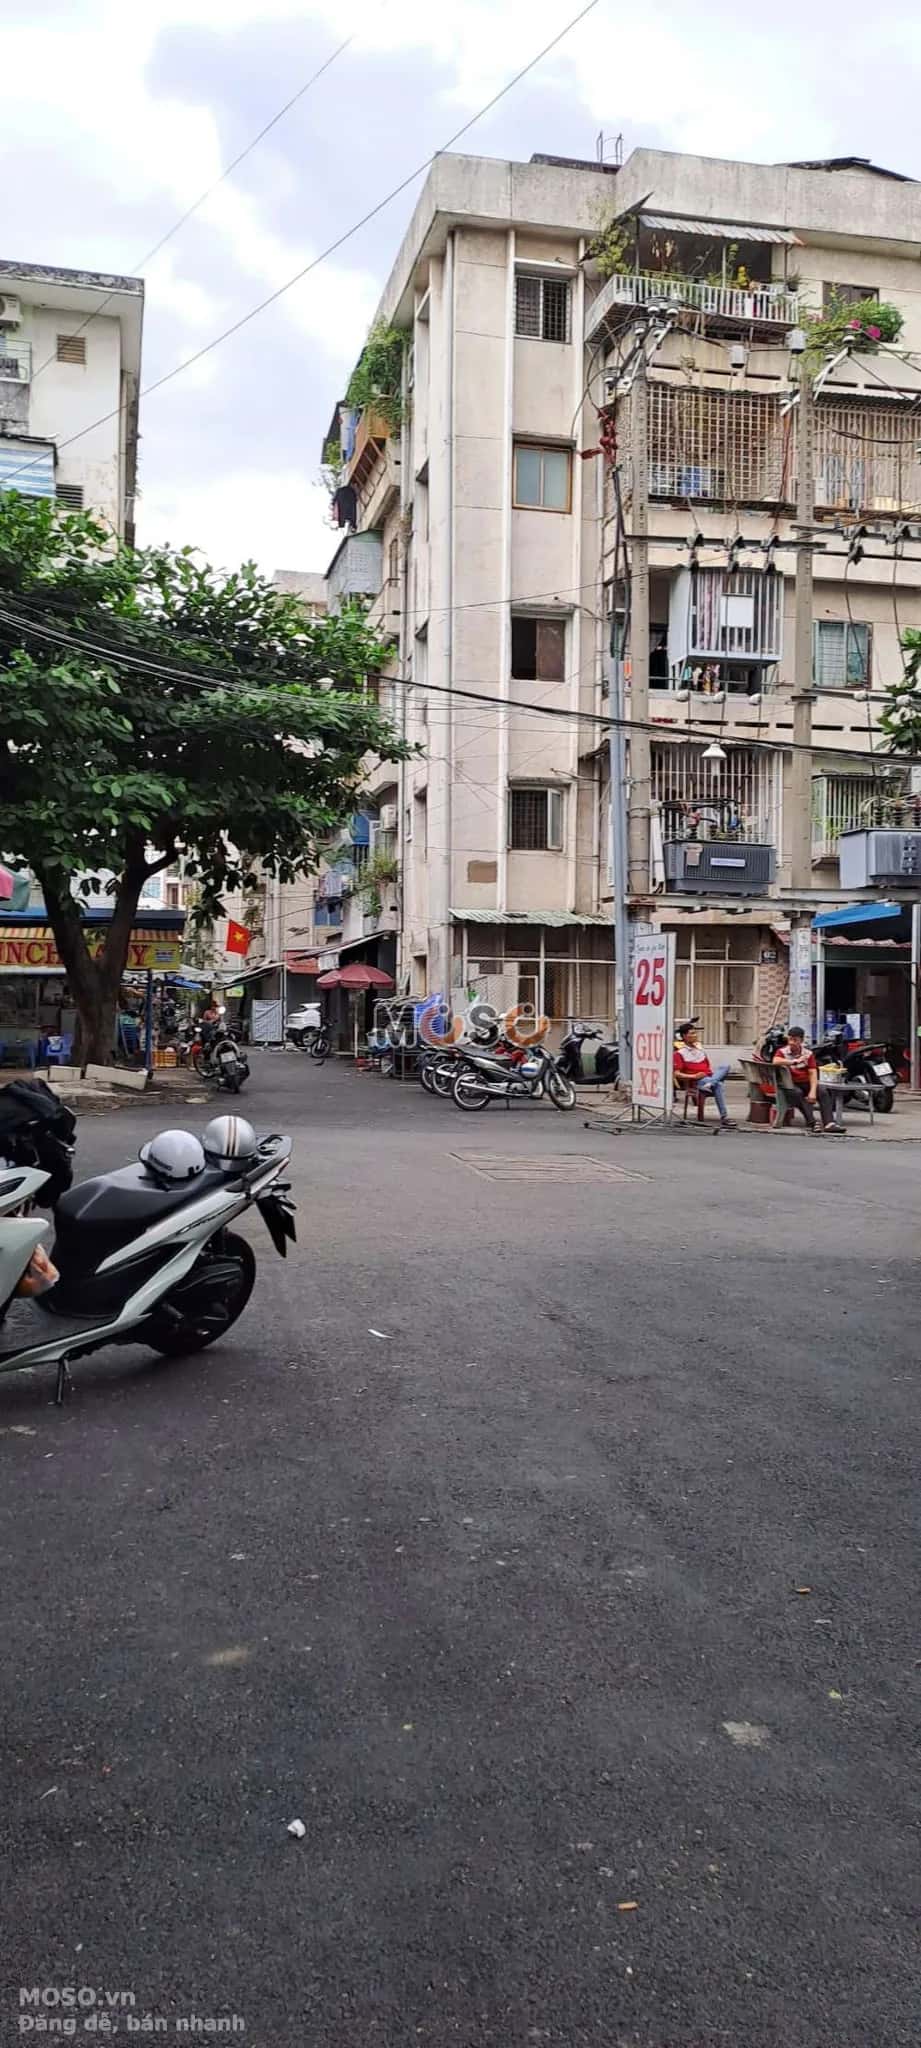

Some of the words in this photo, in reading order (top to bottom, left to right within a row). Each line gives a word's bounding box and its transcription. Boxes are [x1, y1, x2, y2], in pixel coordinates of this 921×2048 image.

[0, 942, 64, 965] NCH
[635, 957, 665, 1006] 25
[638, 1067, 660, 1098] XE
